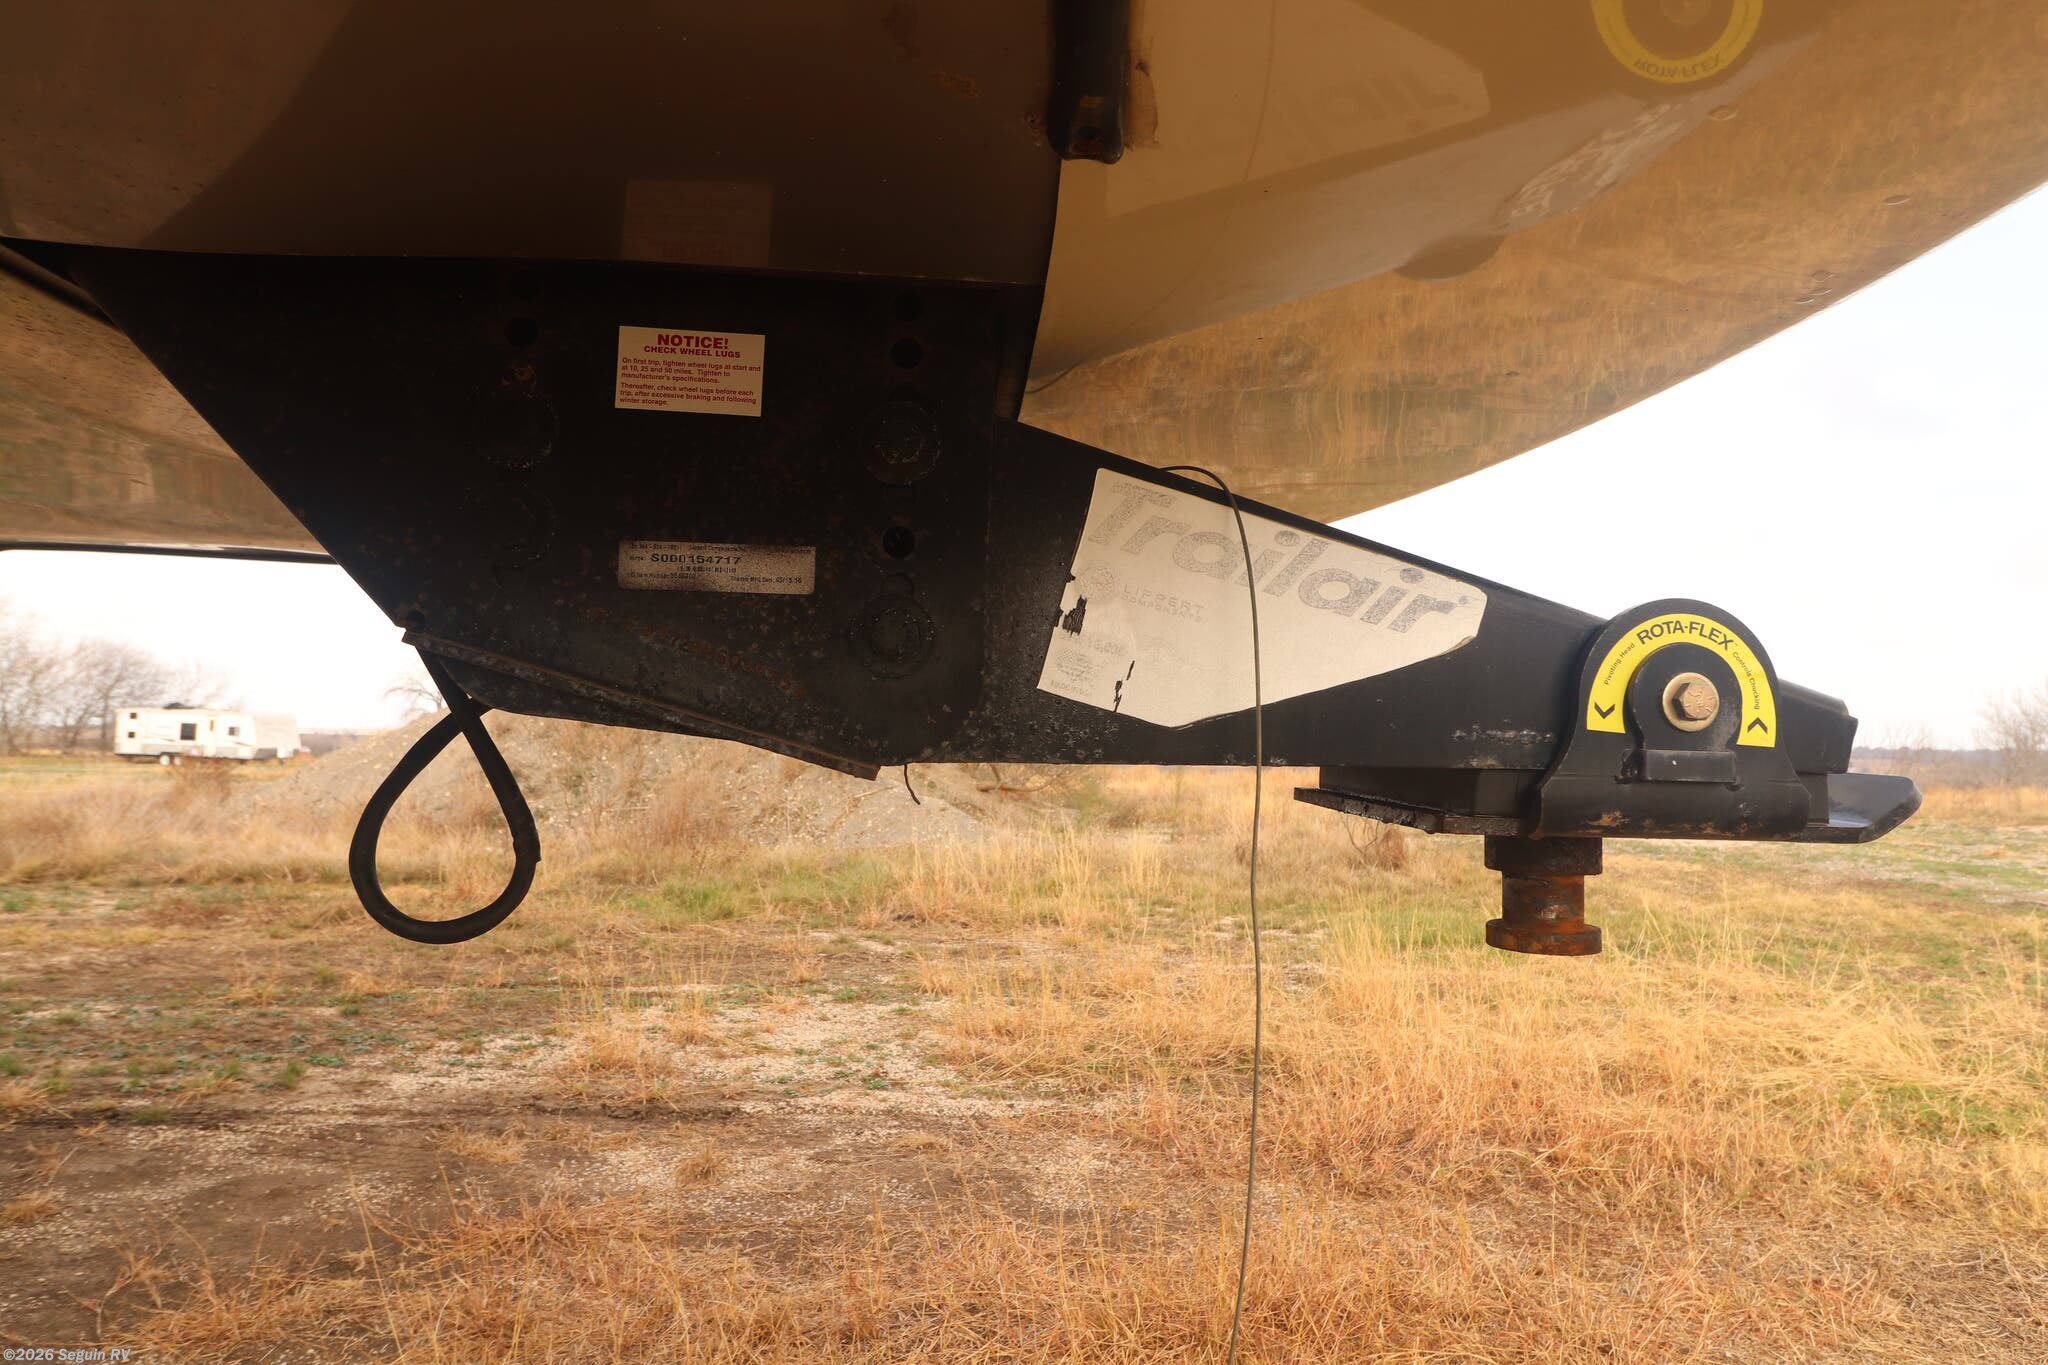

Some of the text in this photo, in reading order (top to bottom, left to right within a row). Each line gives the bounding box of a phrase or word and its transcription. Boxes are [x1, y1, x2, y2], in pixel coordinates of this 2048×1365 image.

[657, 334, 729, 349] NOTICE!
[644, 345, 741, 358] CHECK WHEEL LUGS
[663, 360, 686, 368] tighten
[687, 361, 707, 369] wheel
[621, 373, 720, 384] manufacturer's specifications.
[698, 369, 722, 377] Tighten
[621, 383, 655, 391] Thereafter,
[686, 394, 711, 402] braking
[726, 396, 757, 404] following
[1088, 479, 1457, 633] Trailair
[1124, 584, 1204, 615] LIPPERT
[1637, 620, 1733, 651] ROTA-FLEX
[1604, 643, 1635, 686] Pivoting Head
[1733, 651, 1760, 710] Controls Chucking
